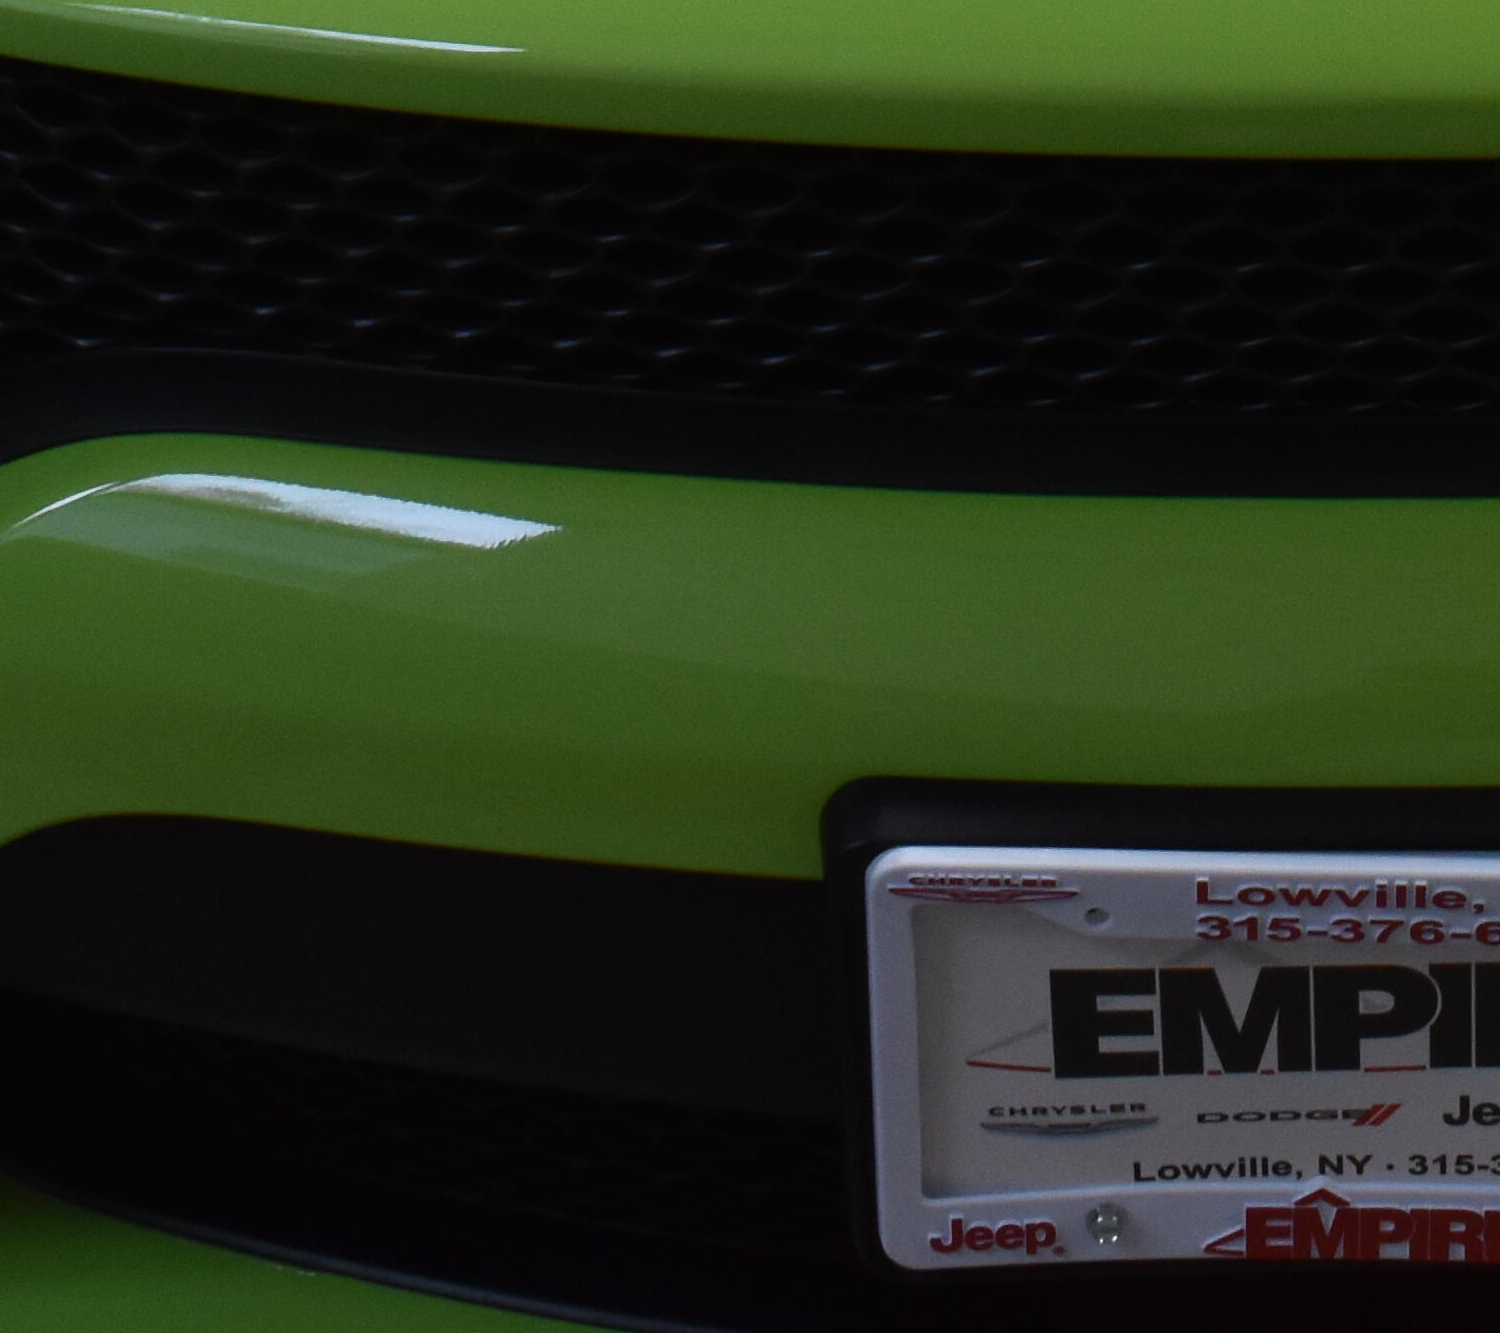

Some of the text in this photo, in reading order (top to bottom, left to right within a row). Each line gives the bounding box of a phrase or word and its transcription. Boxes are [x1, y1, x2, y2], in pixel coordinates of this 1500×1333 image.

[908, 876, 1059, 888] CHRYSLER
[1195, 878, 1485, 914] Lowville,
[988, 1102, 1148, 1117] CHRYSLER
[1197, 1108, 1369, 1125] DODGE
[1133, 1156, 1304, 1182] Lowville,
[1318, 1154, 1373, 1176] NY
[929, 1217, 1058, 1255] Jeep
